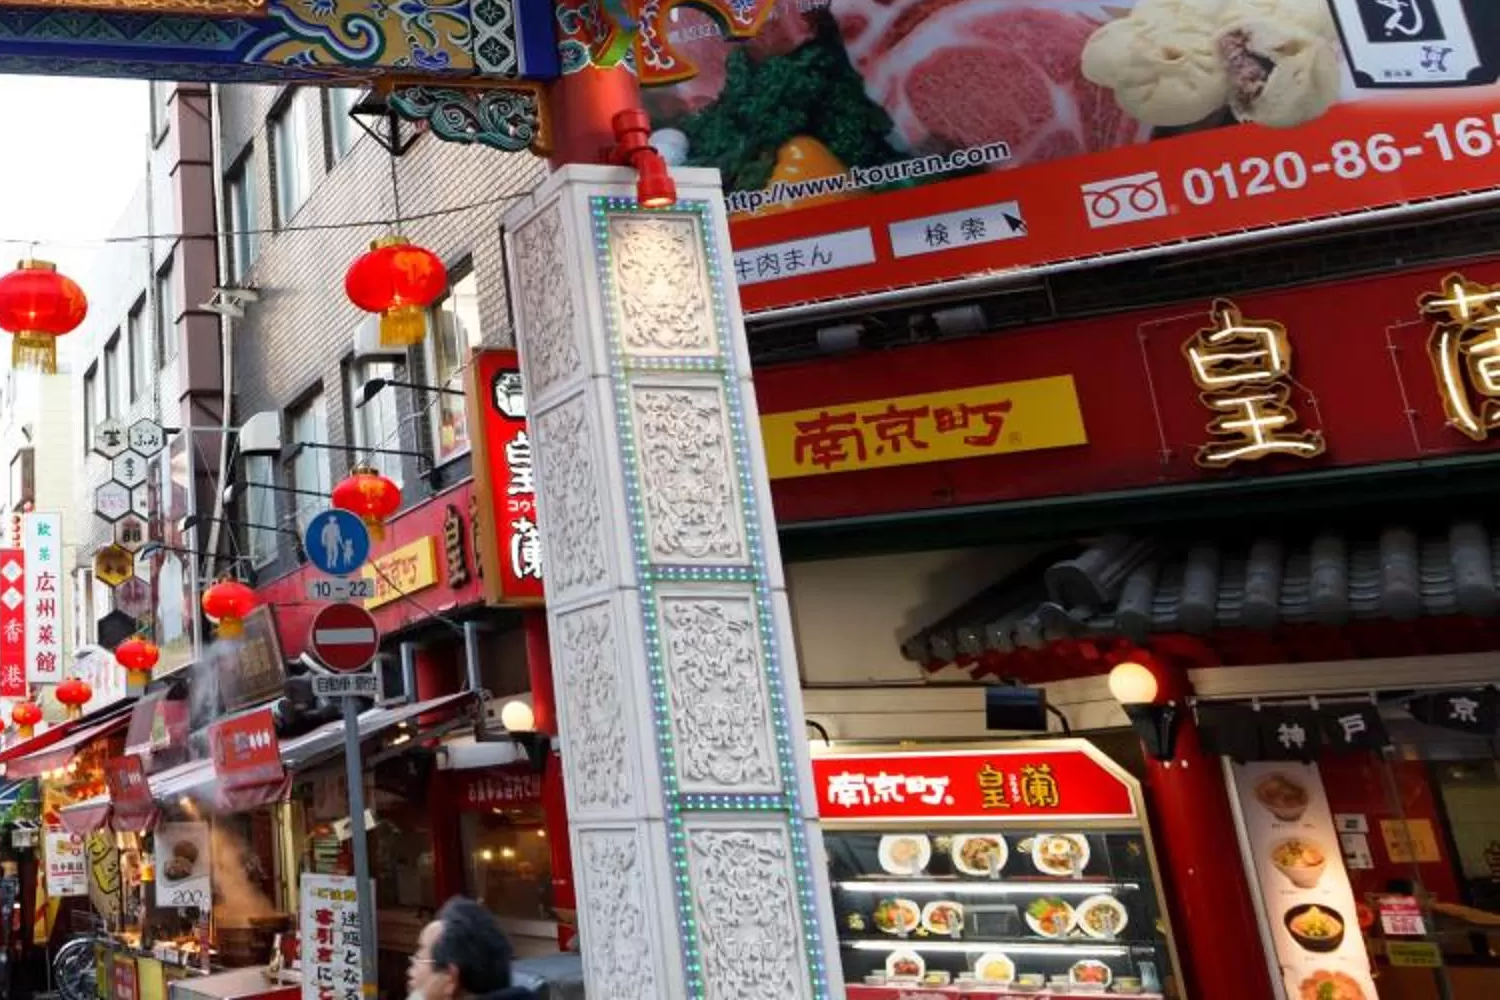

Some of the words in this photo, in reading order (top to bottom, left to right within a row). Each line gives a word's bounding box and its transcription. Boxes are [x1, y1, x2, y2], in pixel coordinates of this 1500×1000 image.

[925, 217, 987, 248] 検索
[794, 399, 1013, 470] 南京町
[507, 500, 536, 512] コウ
[1, 617, 24, 688] 香港
